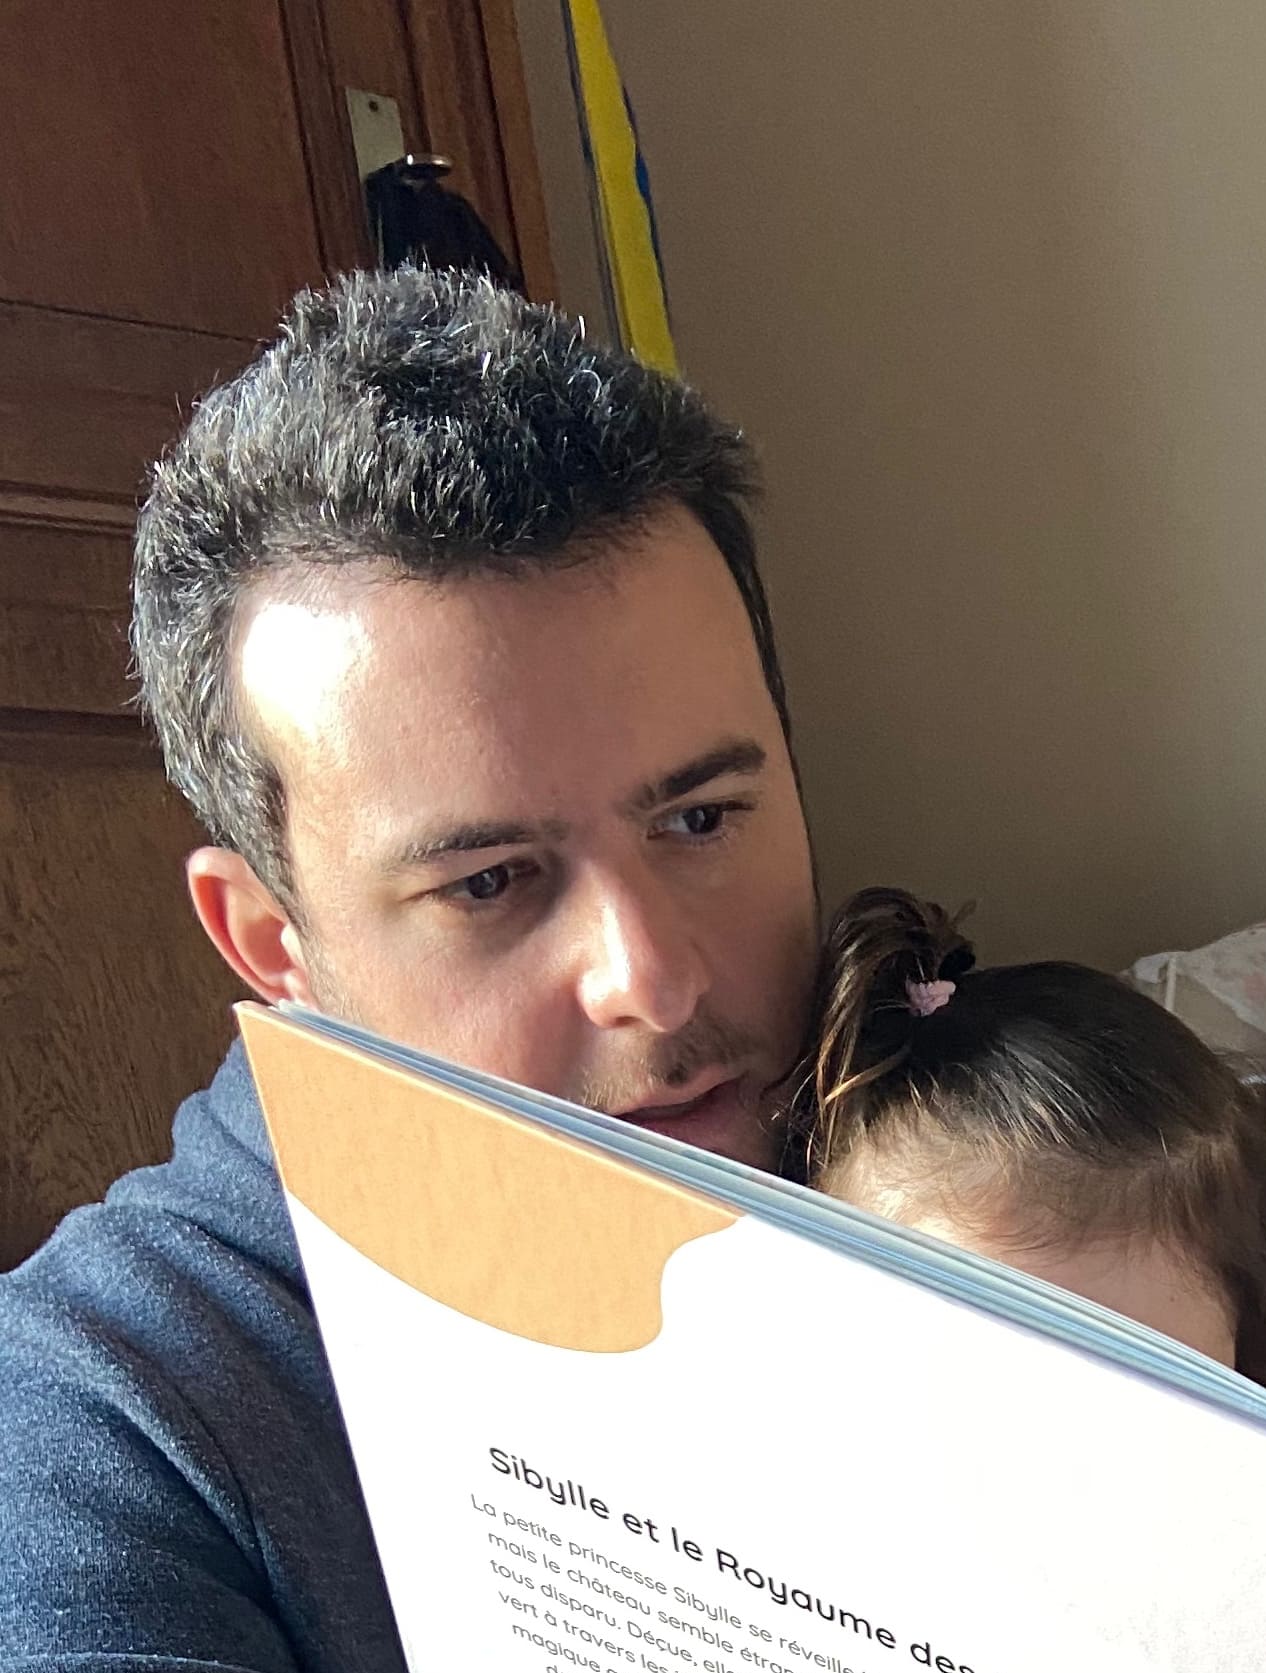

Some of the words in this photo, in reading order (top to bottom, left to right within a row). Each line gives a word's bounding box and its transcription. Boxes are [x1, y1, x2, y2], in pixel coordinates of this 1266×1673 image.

[471, 1493, 497, 1518] La
[503, 1511, 562, 1547] petite
[568, 1541, 667, 1595] princesse
[673, 1586, 743, 1629] Sibylle
[748, 1624, 773, 1643] se
[488, 1533, 538, 1564] mais
[542, 1553, 561, 1574] le
[566, 1569, 651, 1615] château
[657, 1611, 734, 1654] semble
[489, 1447, 610, 1520] Sibylle
[622, 1512, 660, 1544] et
[671, 1526, 704, 1562] le
[715, 1547, 897, 1650] Royaume
[489, 1559, 535, 1590] tous
[540, 1584, 621, 1630] disparu.
[627, 1620, 698, 1667] Déçue,
[498, 1591, 539, 1619] vert
[544, 1610, 558, 1627] à
[562, 1619, 636, 1663] travers
[512, 1624, 601, 1673] magique
